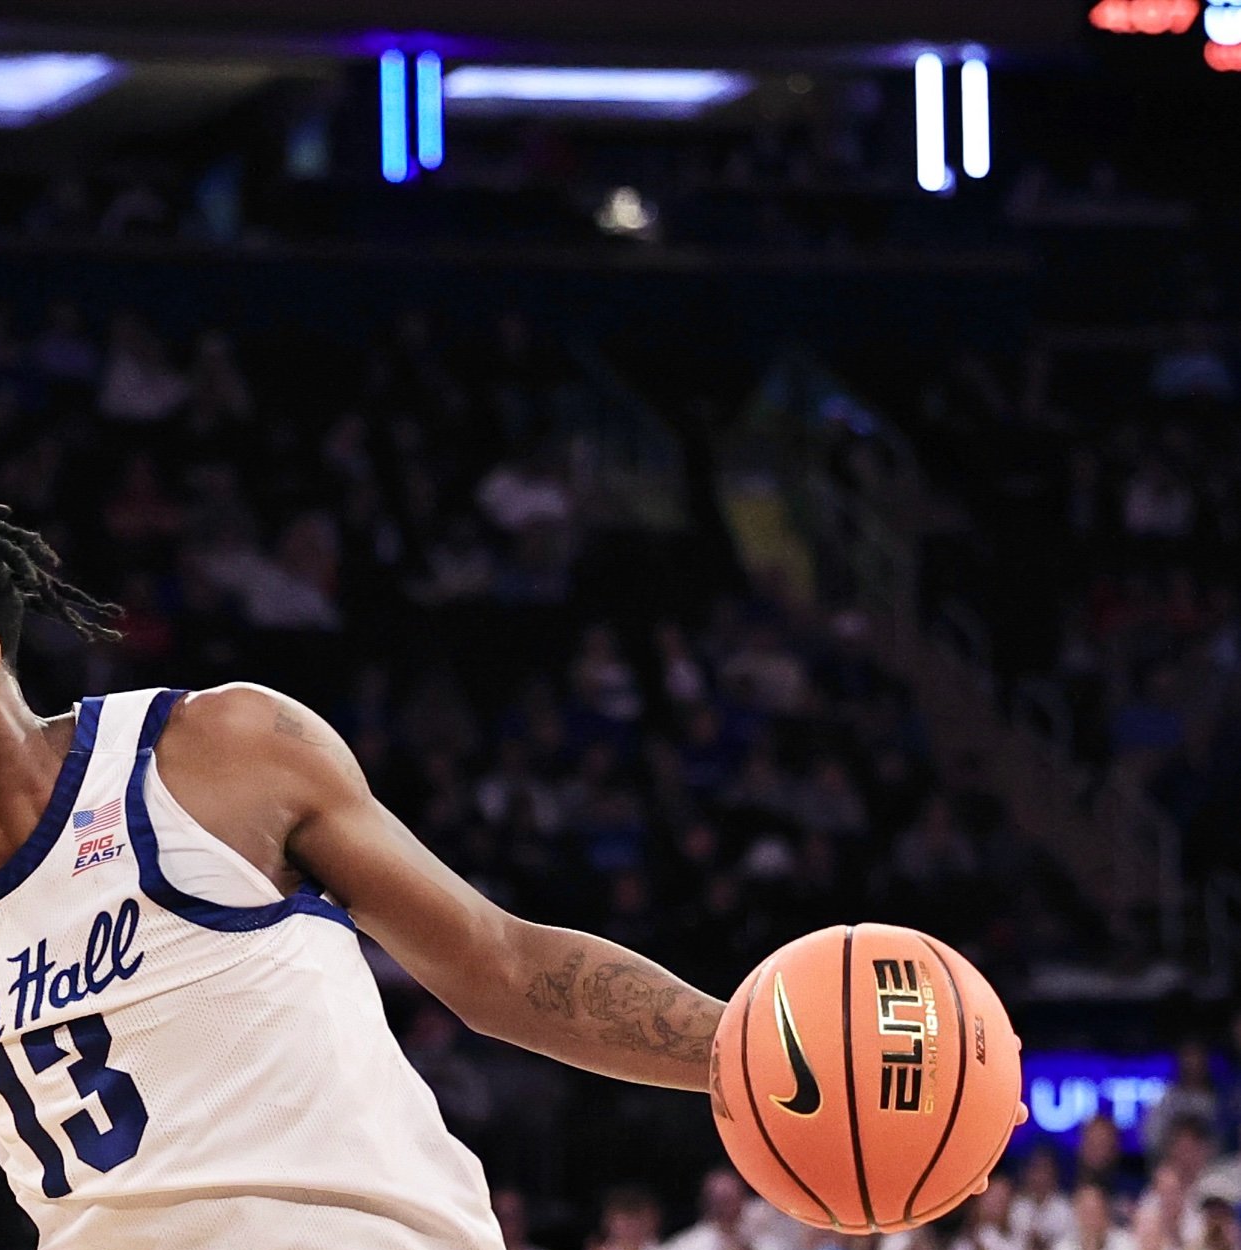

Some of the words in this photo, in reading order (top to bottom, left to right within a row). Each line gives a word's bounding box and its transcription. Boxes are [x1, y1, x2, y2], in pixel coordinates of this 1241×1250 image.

[74, 843, 126, 869] EAST
[78, 834, 114, 856] BIG
[7, 898, 145, 1029] Hall
[872, 959, 924, 1112] ELITE
[918, 960, 939, 1114] CHAMPIONSHIP
